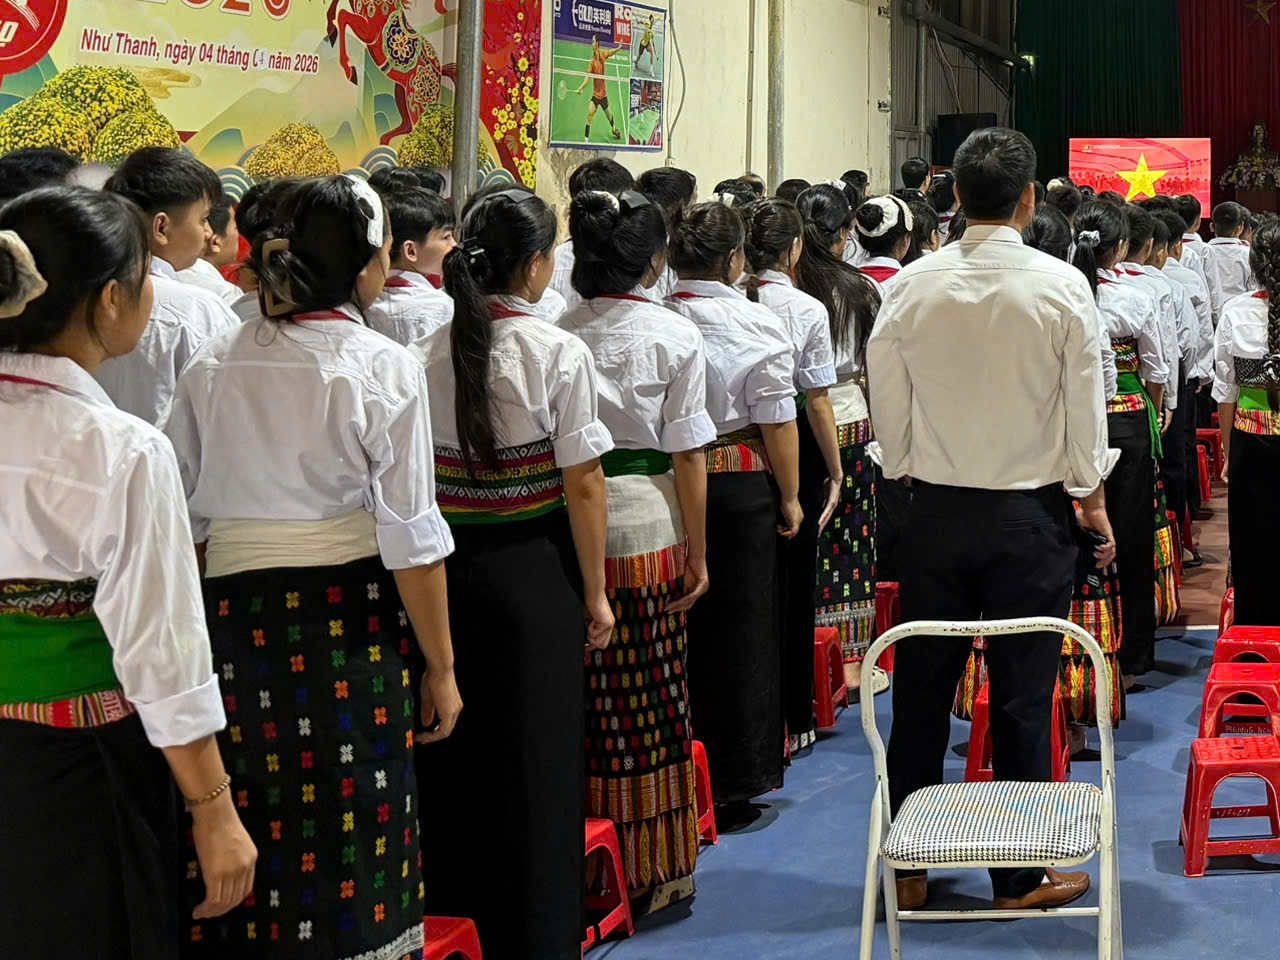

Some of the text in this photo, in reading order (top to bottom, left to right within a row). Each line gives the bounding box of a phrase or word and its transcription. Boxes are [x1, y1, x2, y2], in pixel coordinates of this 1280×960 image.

[80, 28, 113, 53] Như
[116, 32, 161, 61] Thanh,
[164, 39, 197, 66] ngày
[199, 42, 214, 63] 04
[216, 44, 250, 72] tháng
[268, 51, 292, 71] năm
[294, 53, 319, 74] 2026
